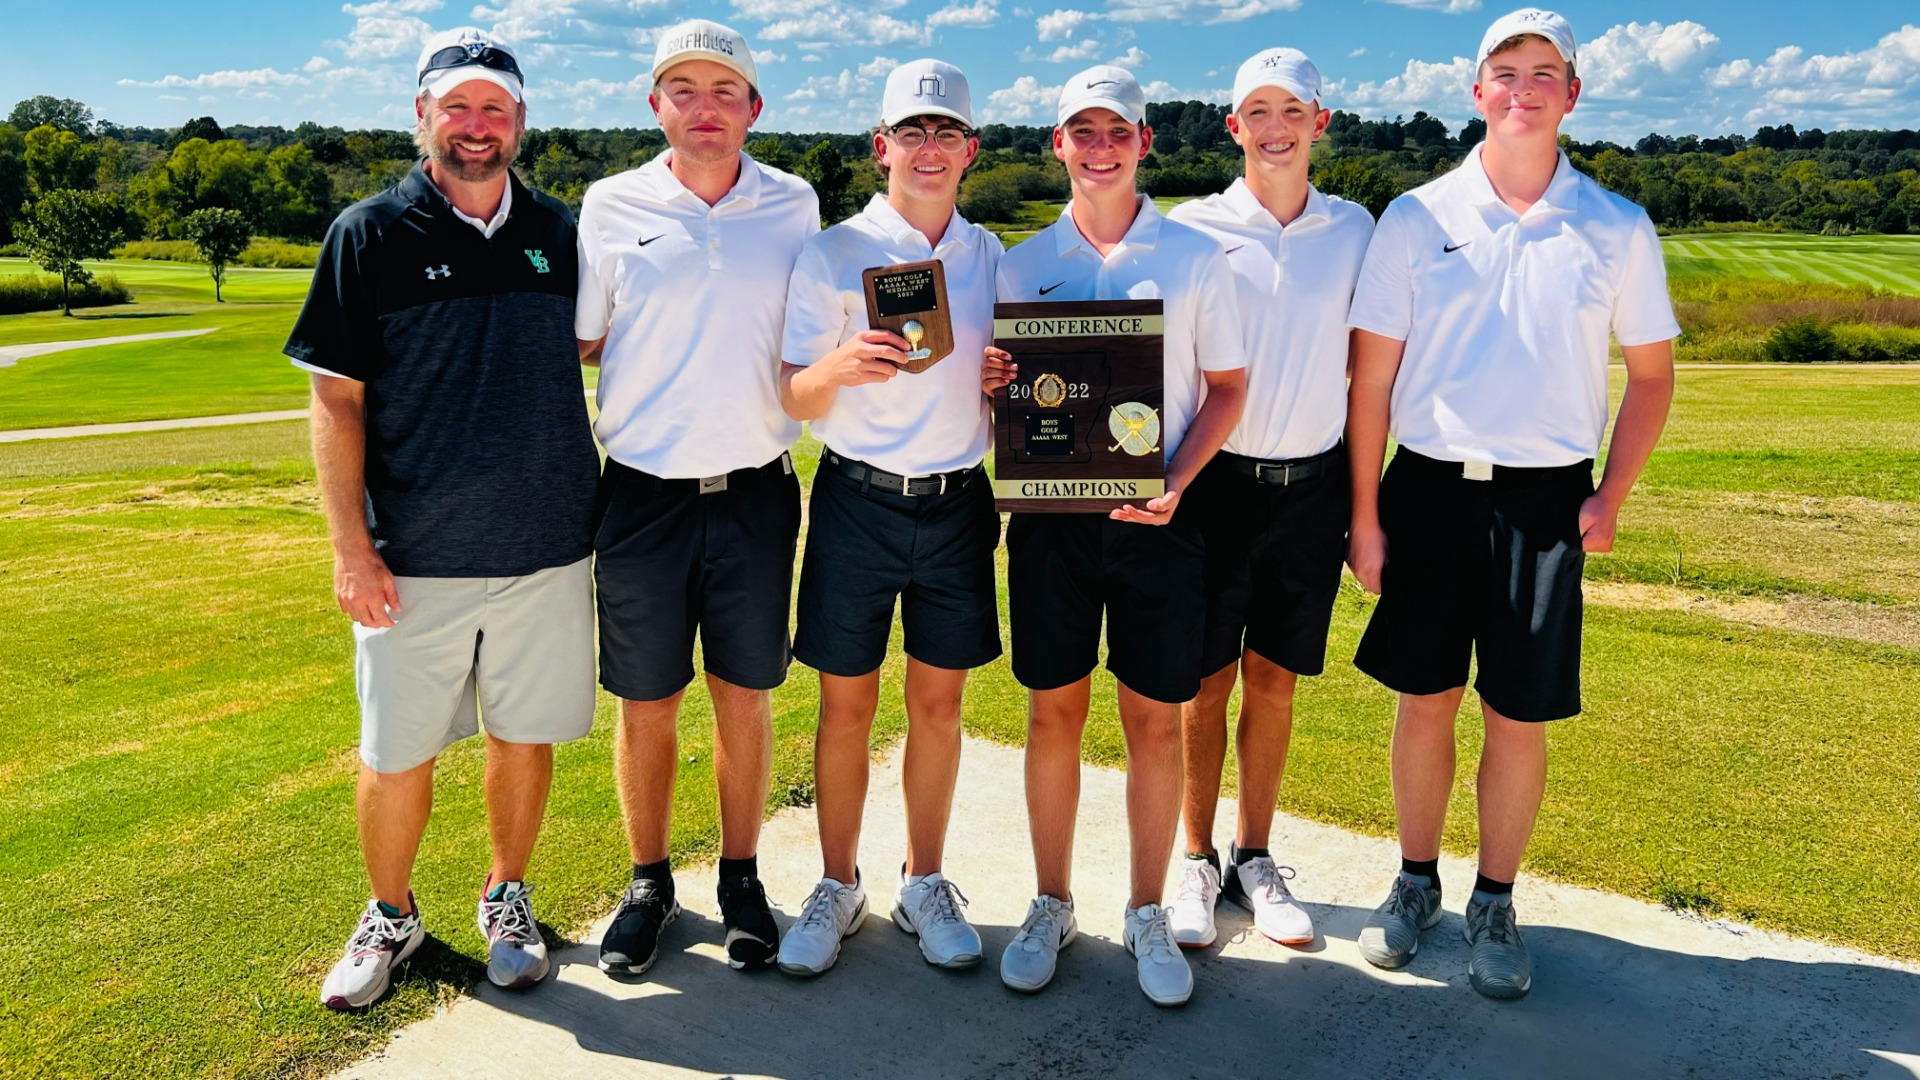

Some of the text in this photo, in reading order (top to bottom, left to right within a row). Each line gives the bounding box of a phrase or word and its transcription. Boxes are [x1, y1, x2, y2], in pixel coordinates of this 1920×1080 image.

[667, 33, 733, 55] GOLFHOLICS
[524, 249, 550, 273] VB
[879, 282, 906, 290] AAAAA
[886, 285, 923, 294] MEDALIST
[1015, 318, 1143, 335] CONFERENCE
[1021, 482, 1137, 497] CHAMPIONS
